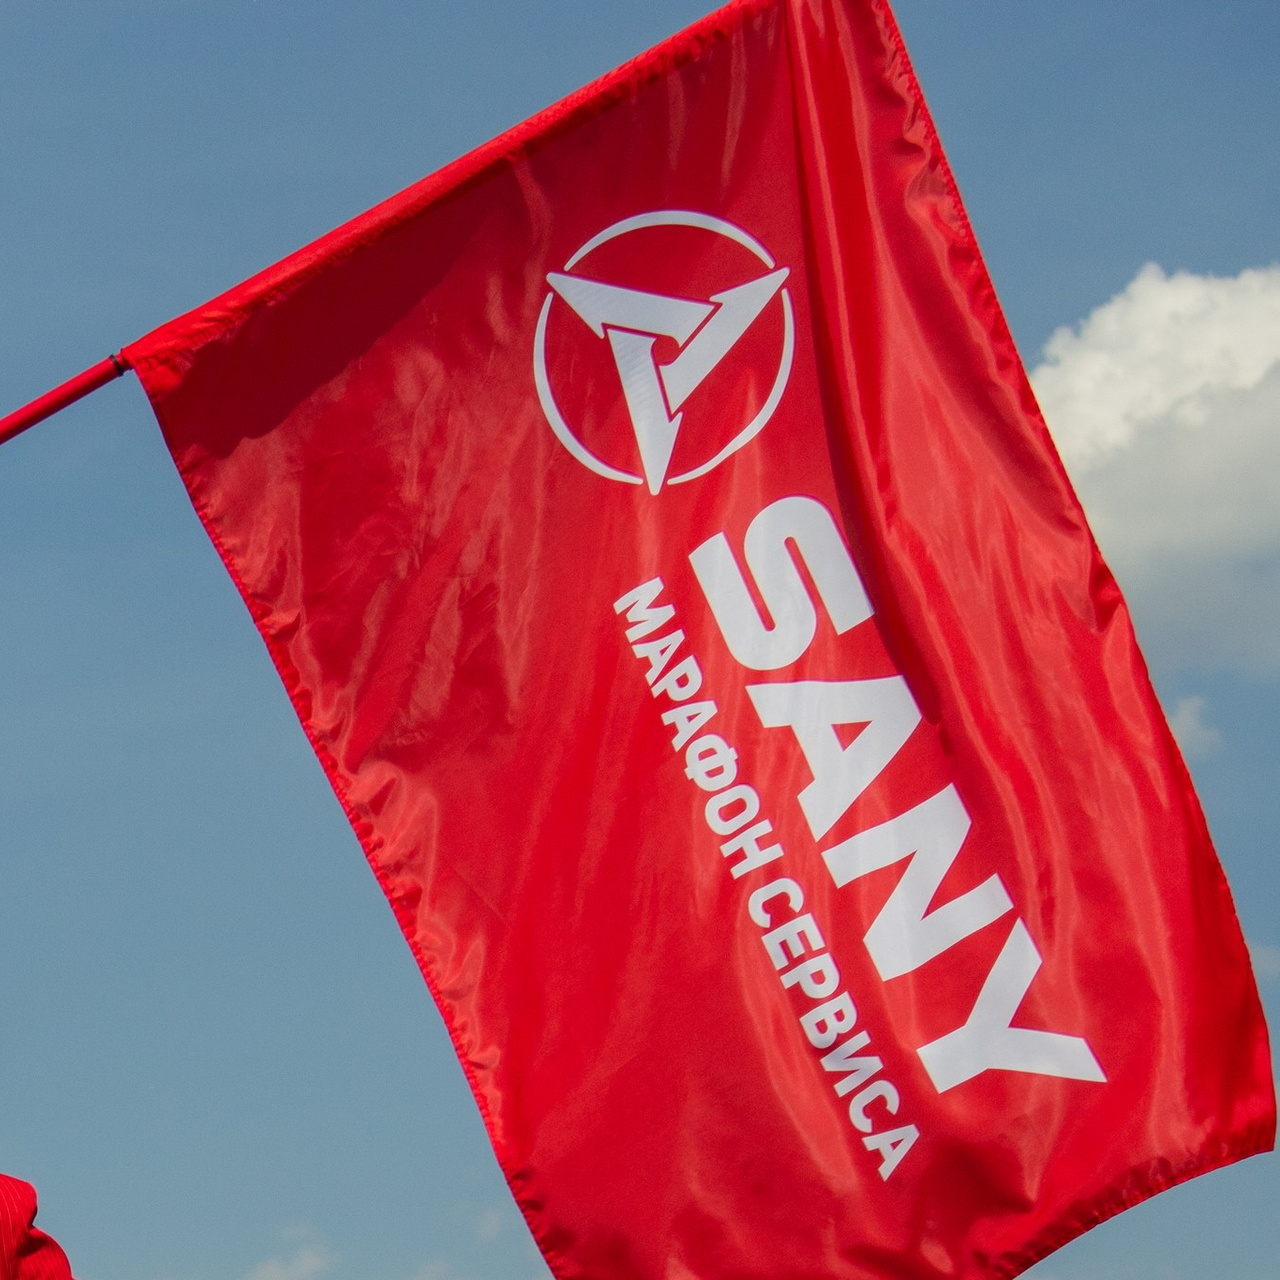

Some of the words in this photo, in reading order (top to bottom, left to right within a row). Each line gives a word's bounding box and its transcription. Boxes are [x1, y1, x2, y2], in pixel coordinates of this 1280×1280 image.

[613, 577, 784, 880] МАРАФОН
[747, 877, 920, 1181] СЕРВИСА
[688, 496, 1107, 1094] SANY
